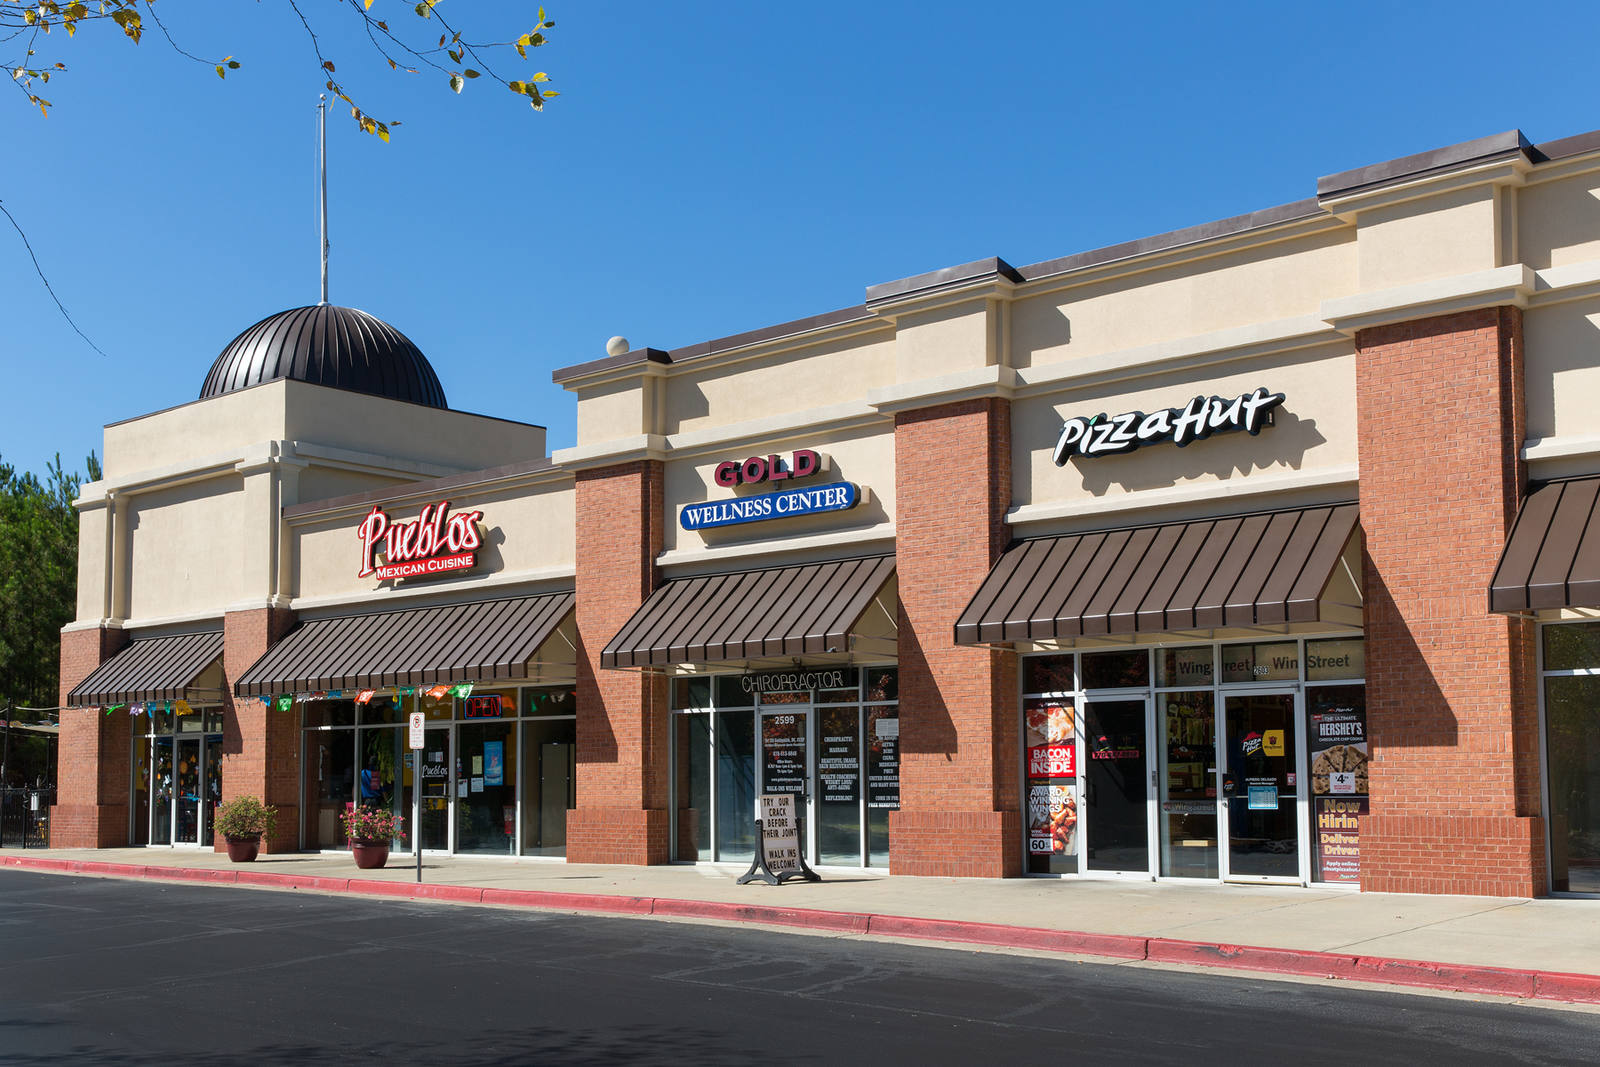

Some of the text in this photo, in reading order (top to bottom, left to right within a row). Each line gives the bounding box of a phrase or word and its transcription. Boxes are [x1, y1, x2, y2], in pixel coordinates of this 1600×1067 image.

[1053, 390, 1278, 462] Pizza Hut
[715, 450, 817, 487] GOLD
[687, 487, 848, 526] WELLNESS CENTER
[358, 501, 480, 578] Pueblos
[377, 555, 473, 579] MEXICAN CUISINE
[1179, 655, 1350, 675] Wingreet WinStreet
[742, 671, 844, 692] CHIROPRACTOR
[465, 696, 500, 717] OPEN
[774, 715, 795, 725] 2599
[1319, 722, 1362, 736] HERSHEY'S
[1242, 738, 1262, 751] Pizza
[1246, 743, 1260, 753] Hut
[1033, 748, 1072, 760] BACON.
[422, 765, 448, 778] Pueblos
[1031, 761, 1073, 774] INSIDE.
[763, 797, 789, 806] TRY OUR
[1030, 796, 1070, 805] WINNING
[1324, 799, 1361, 813] Now
[769, 808, 786, 816] CRACK
[1030, 804, 1061, 813] WINGS
[767, 818, 788, 828] BEFORE
[1318, 813, 1359, 828] Hirin
[763, 828, 797, 838] THEIR JOINT
[1320, 833, 1360, 844] Deliver
[1032, 840, 1045, 849] 60
[1324, 845, 1360, 855] Driver
[769, 849, 796, 859] WALK INS
[768, 859, 796, 869] WELCOME
